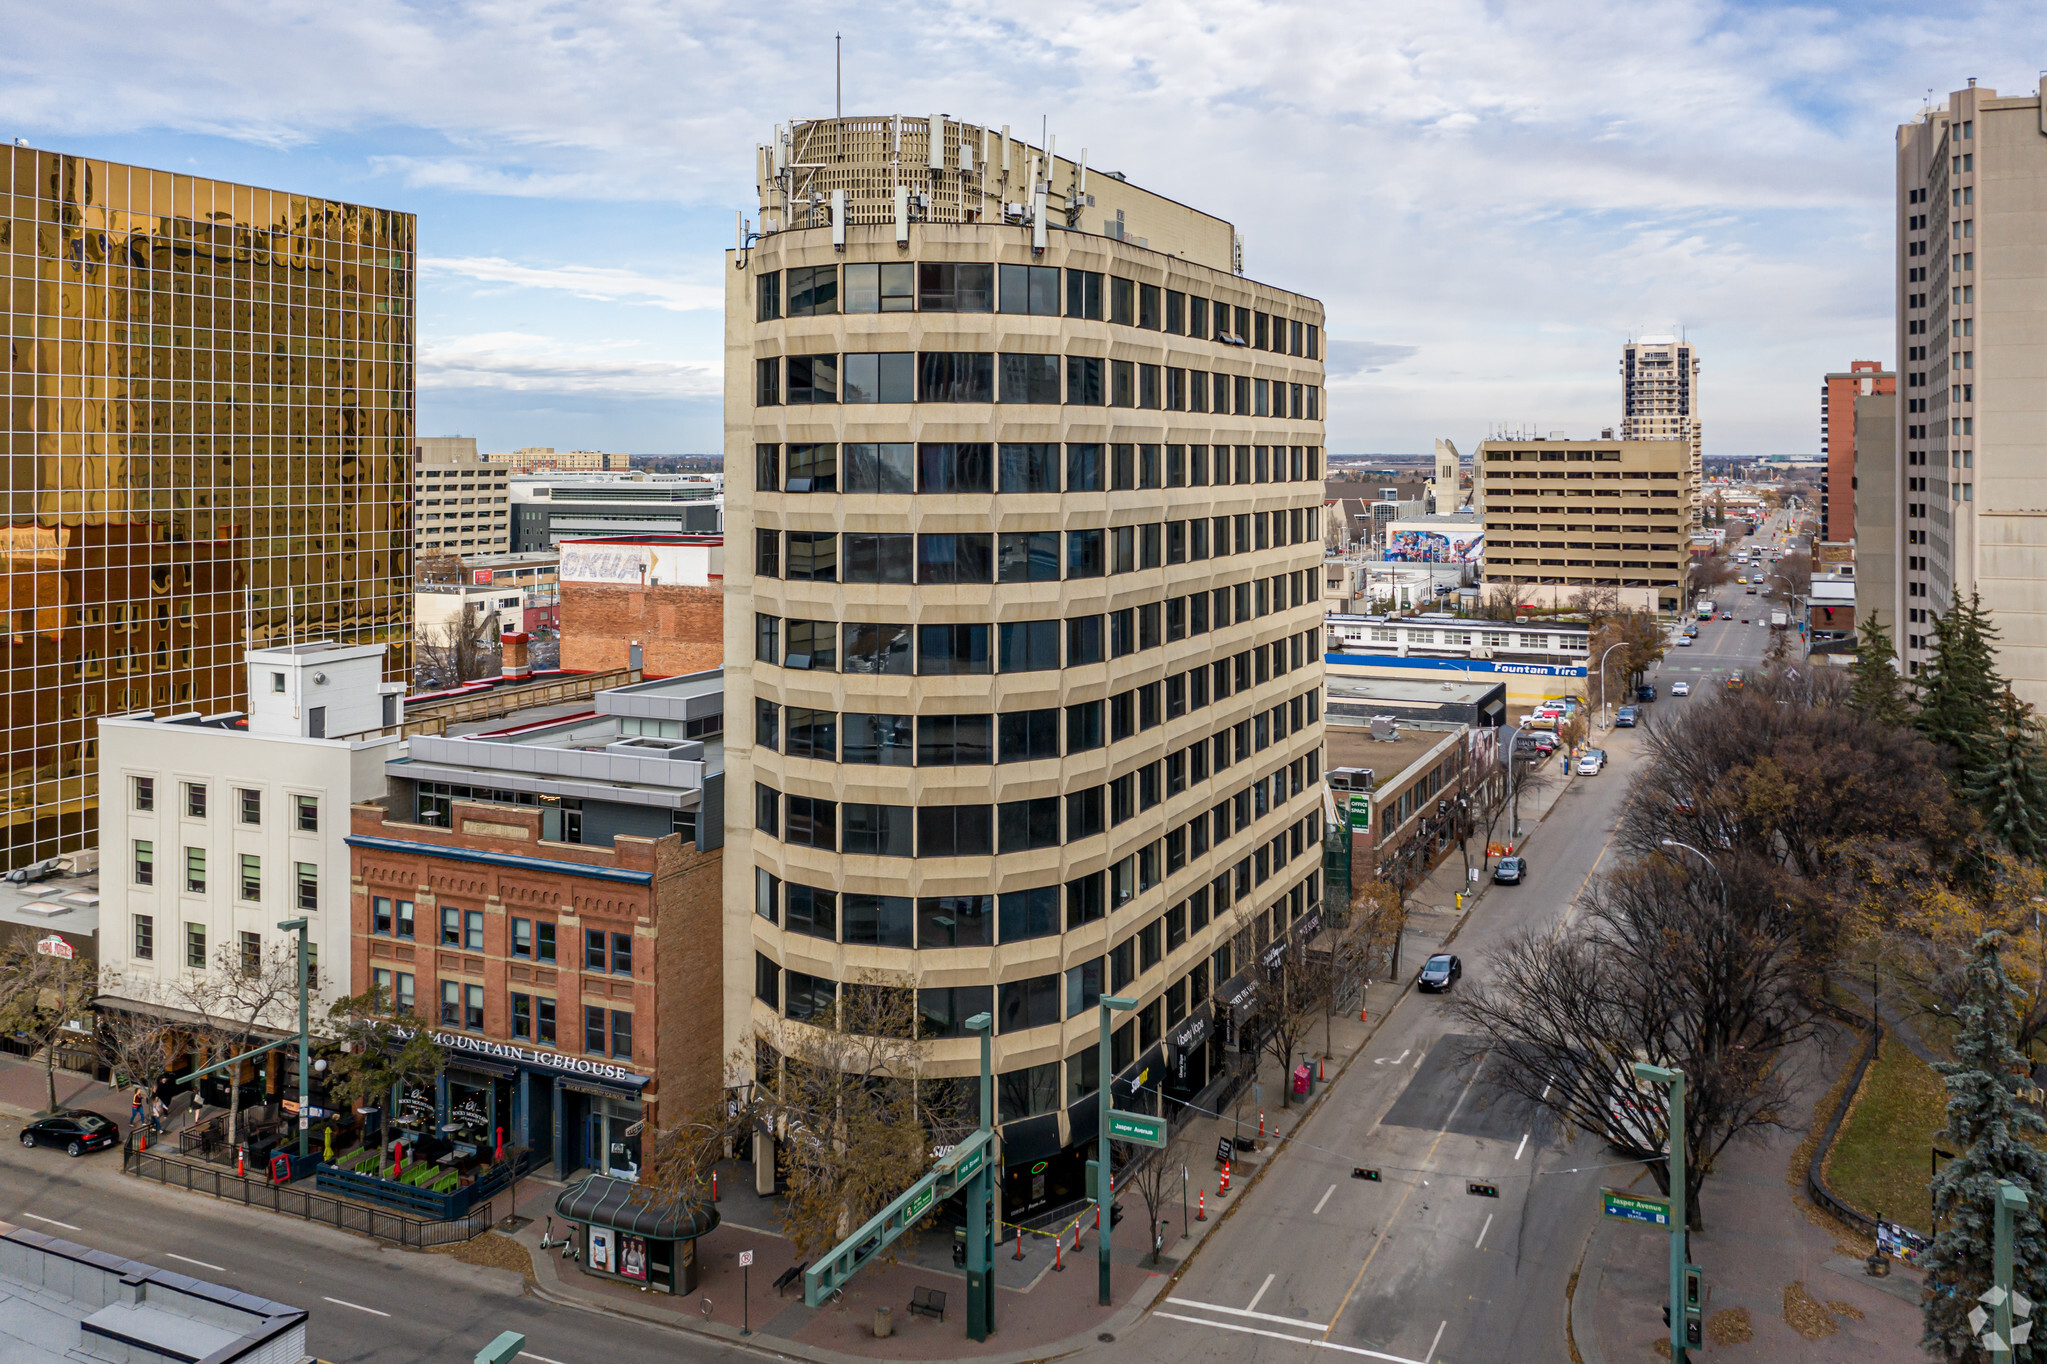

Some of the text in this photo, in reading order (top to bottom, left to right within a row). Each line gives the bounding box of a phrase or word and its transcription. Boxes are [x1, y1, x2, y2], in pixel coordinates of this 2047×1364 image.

[1494, 664, 1577, 676] Fountain Tire
[1177, 1028, 1193, 1045] Liberty
[1191, 1019, 1204, 1035] Vape
[428, 1030, 523, 1060] MOUNTAIN
[533, 1050, 627, 1080] ICEHOUSE
[1130, 1067, 1149, 1094] SUBWAY
[1115, 1123, 1153, 1135] Jasper Avenue
[1613, 1197, 1662, 1212] Jasper Avenue
